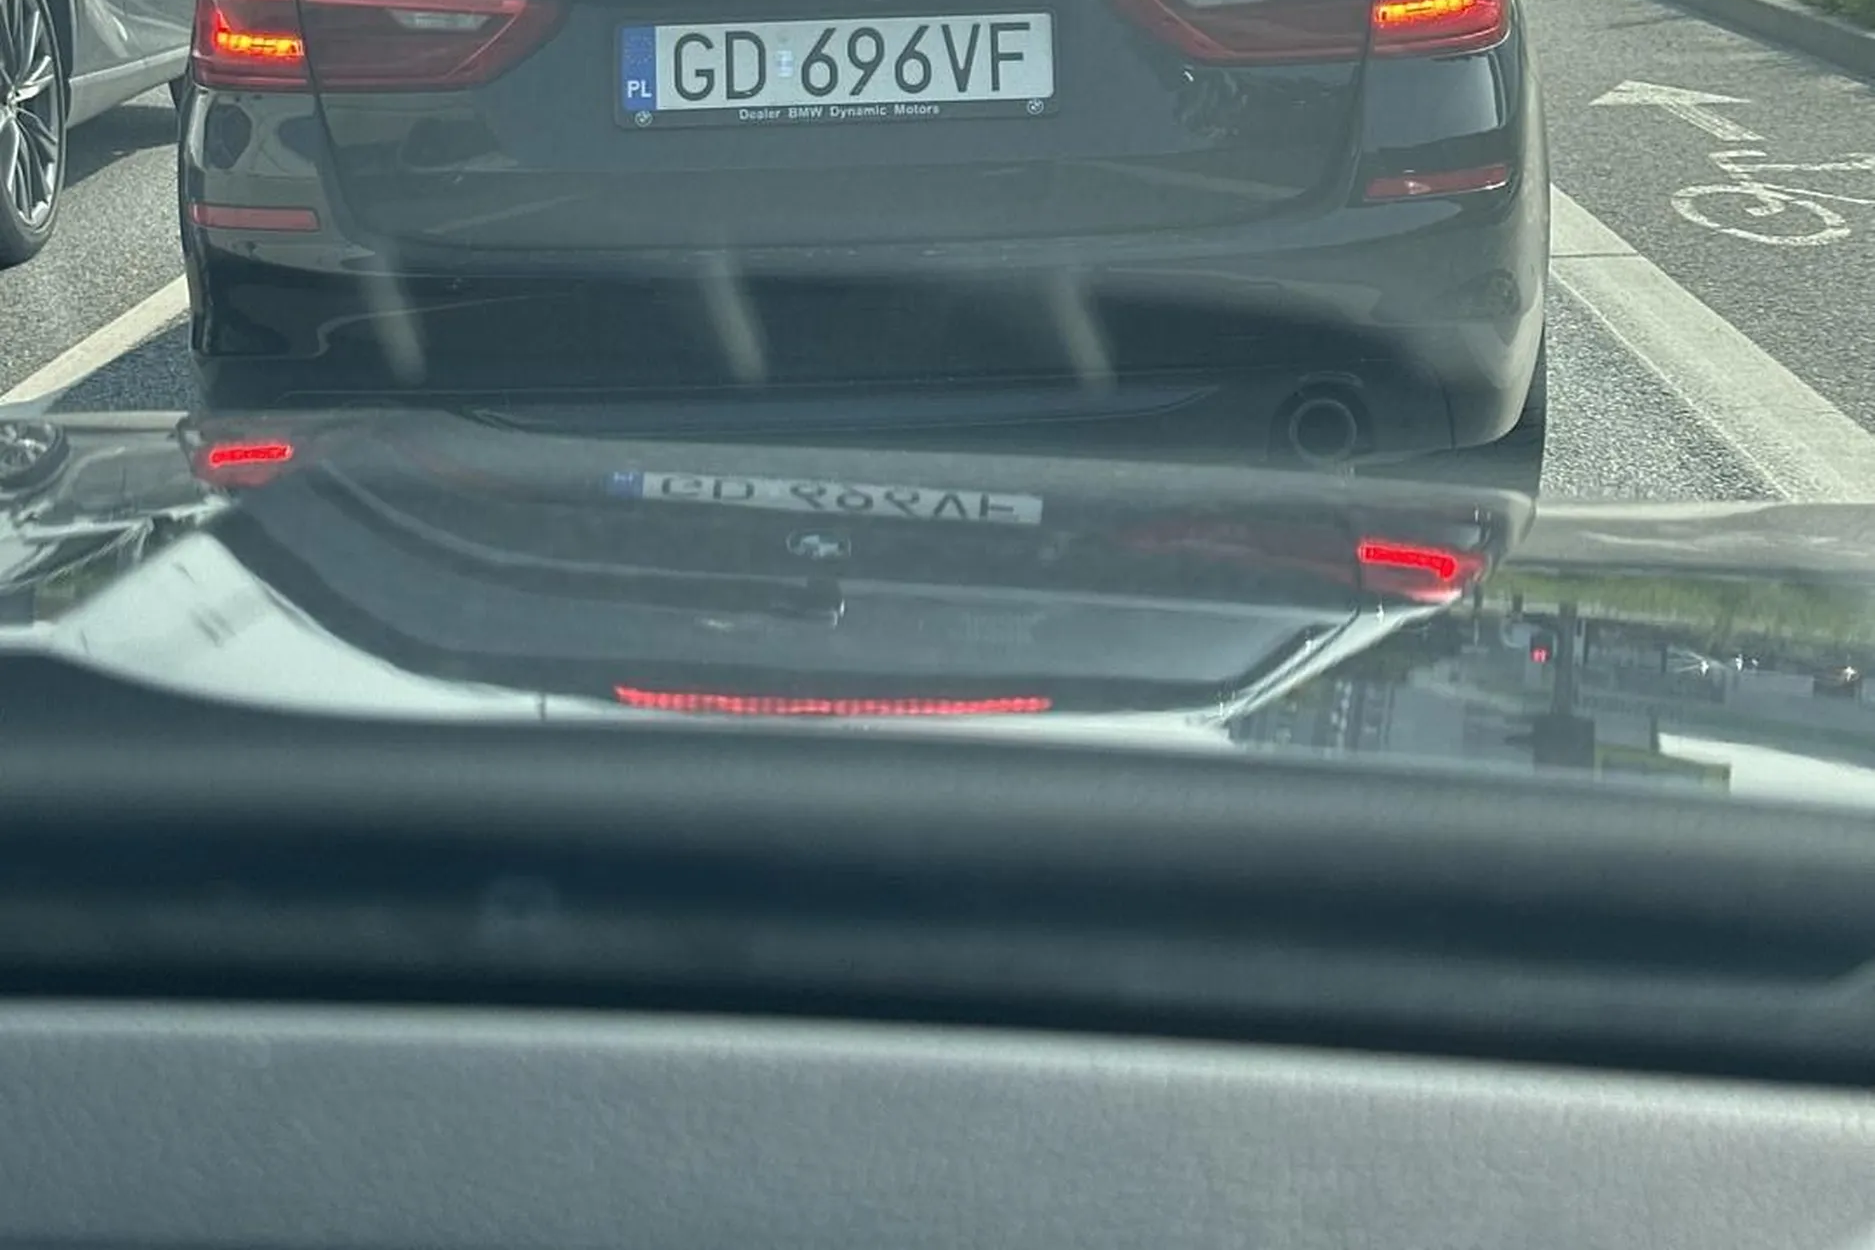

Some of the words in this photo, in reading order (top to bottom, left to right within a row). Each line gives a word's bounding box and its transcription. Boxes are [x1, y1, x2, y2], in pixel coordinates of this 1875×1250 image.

[673, 30, 767, 101] GD
[801, 21, 1031, 97] 696VF
[627, 80, 653, 99] PL
[738, 108, 781, 121] Dealer
[788, 106, 824, 119] BMW
[829, 104, 888, 119] Dynamic
[894, 103, 941, 116] Motors
